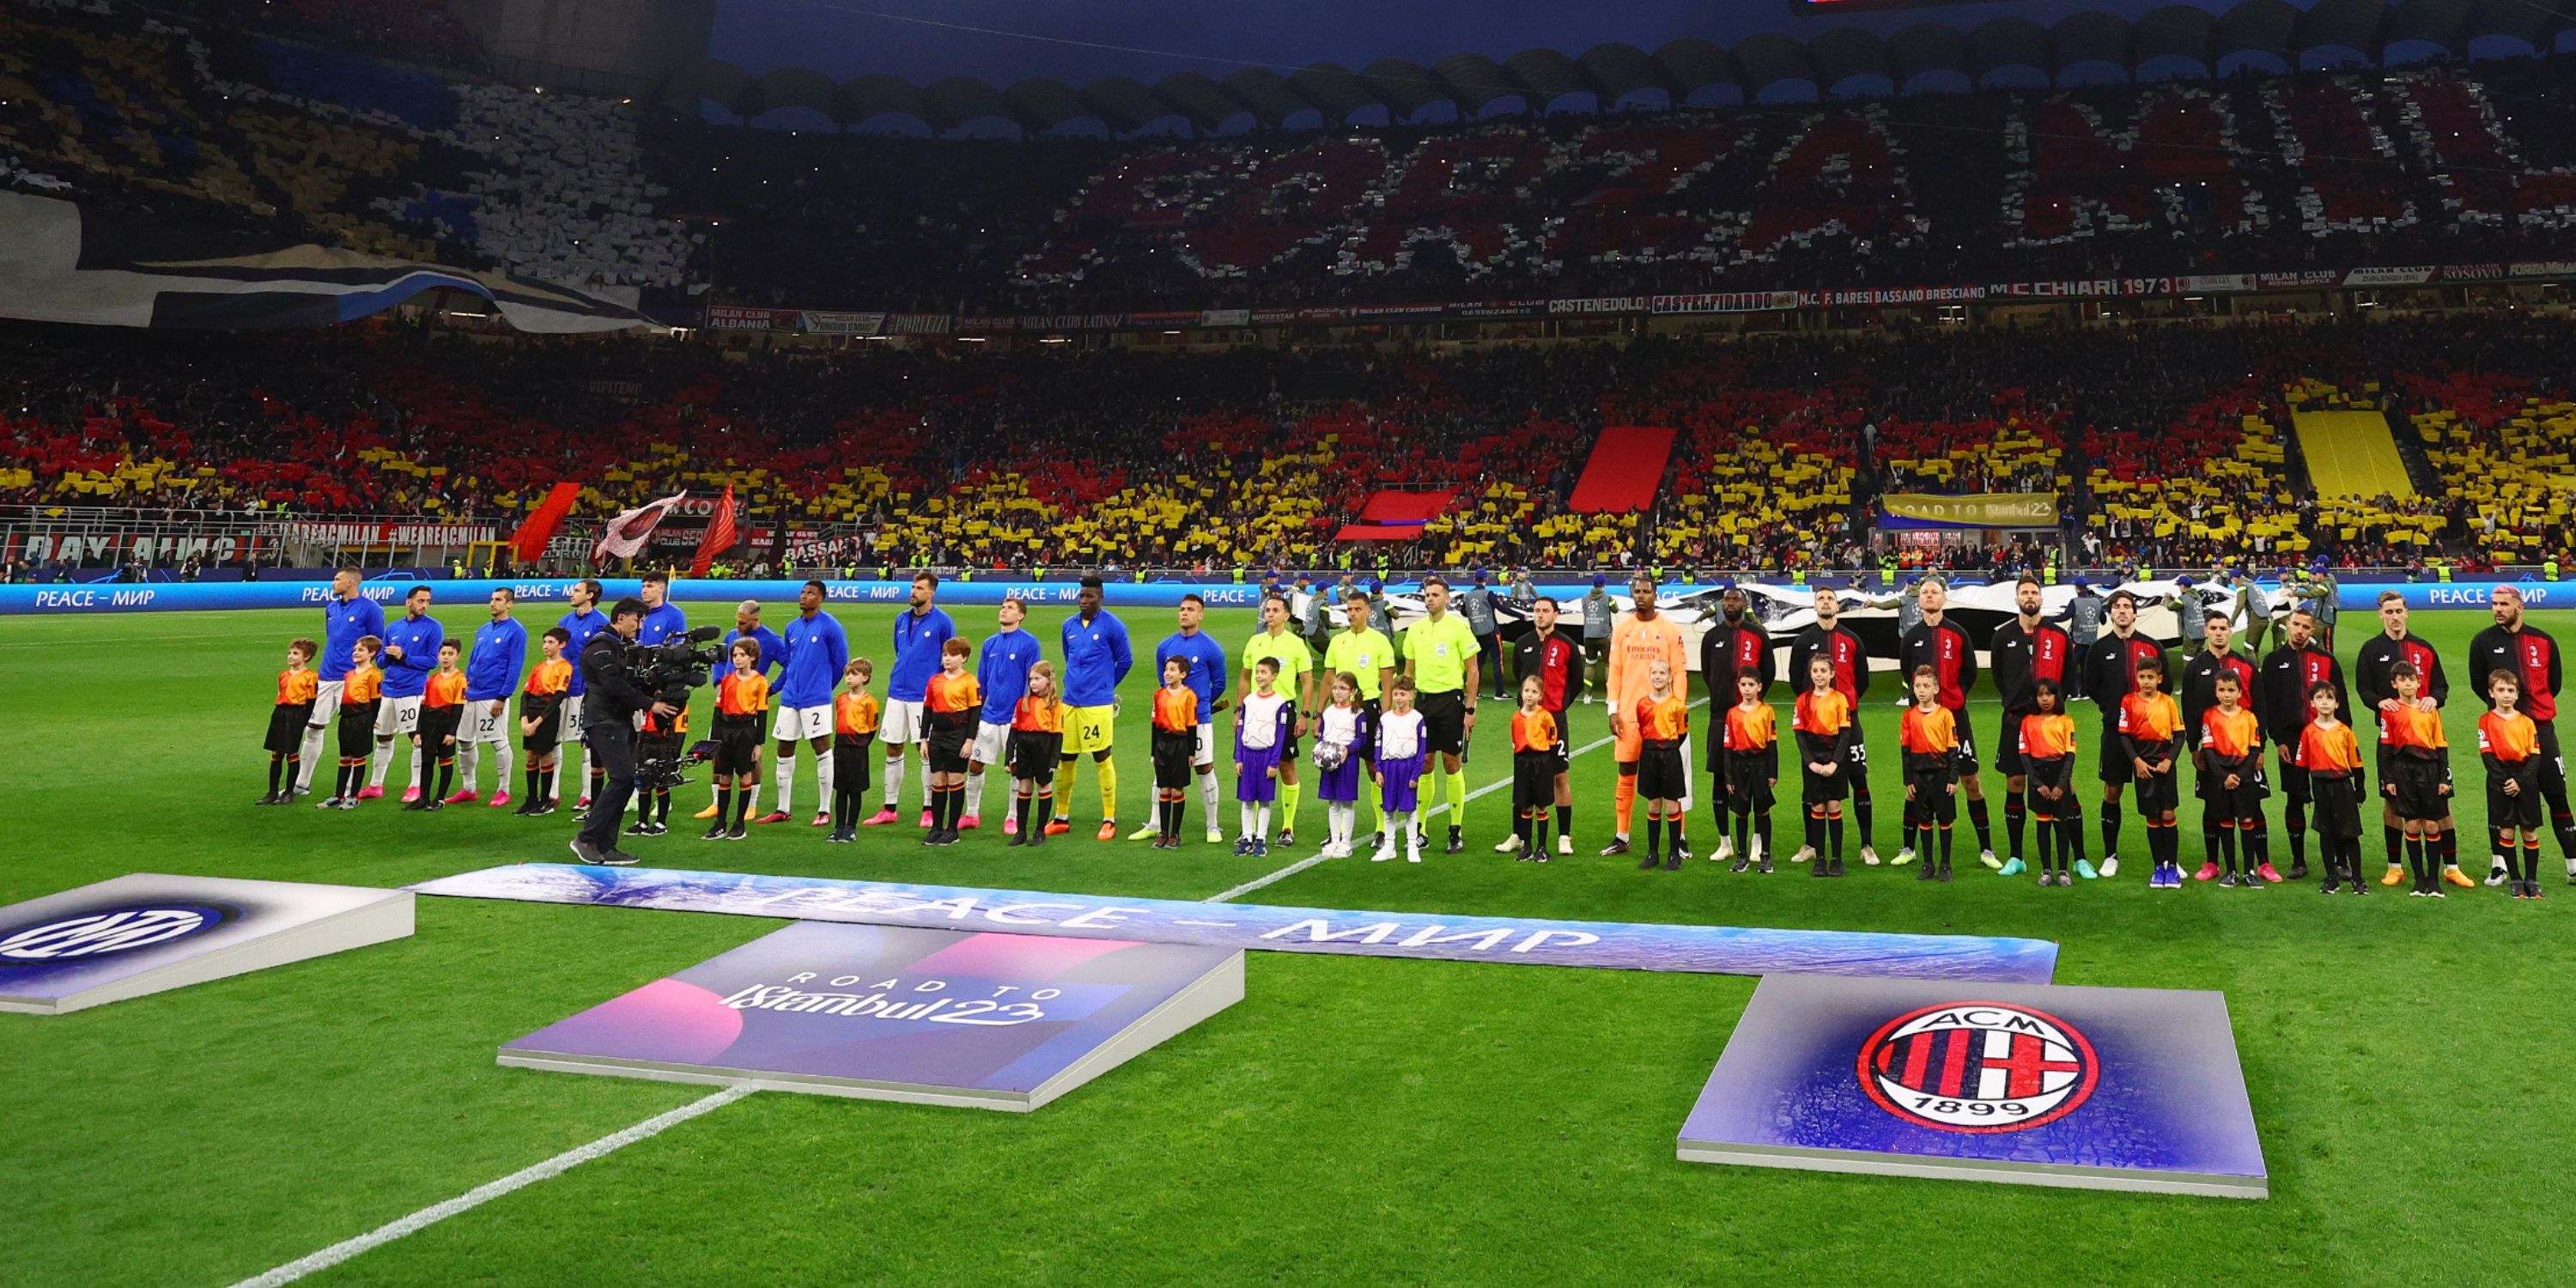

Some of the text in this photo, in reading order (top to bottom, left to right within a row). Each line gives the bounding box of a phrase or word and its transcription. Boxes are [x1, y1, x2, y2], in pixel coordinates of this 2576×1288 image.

[2260, 270, 2336, 281] MILAN CLUB
[2443, 268, 2502, 279] KOSOVO
[2124, 277, 2171, 295] 1973
[1654, 293, 1772, 312] CASTELFIDARDO
[1799, 287, 1985, 305] M.C. F. BARESI BASSANO BRESCIANO
[1549, 297, 1643, 313] CASTENEDOLO
[711, 308, 770, 319] MILAN CLUB
[710, 318, 770, 329] ALBANIA
[1024, 315, 1053, 329] MILAN
[1953, 504, 1978, 516] TO
[388, 526, 495, 545] #WEAREACMILAN
[302, 587, 343, 601] PEAC
[514, 584, 551, 598] PEACE
[826, 586, 859, 598] EACE
[1006, 587, 1046, 600] PEACE
[1059, 588, 1081, 600] МИ
[1203, 589, 1245, 602] PEACE
[2430, 589, 2486, 604] PEACE
[36, 590, 94, 607] PEACE
[400, 708, 416, 722] 20
[812, 713, 820, 726] 2
[479, 718, 495, 732] 22
[1083, 725, 1100, 739] 24
[1850, 744, 1866, 762] 33
[756, 887, 1151, 929] PEACE
[1259, 918, 1601, 952] МИР
[787, 971, 1061, 1000] ROAD TO
[1920, 1010, 2045, 1036] ACM
[1914, 1097, 2029, 1116] 1899
